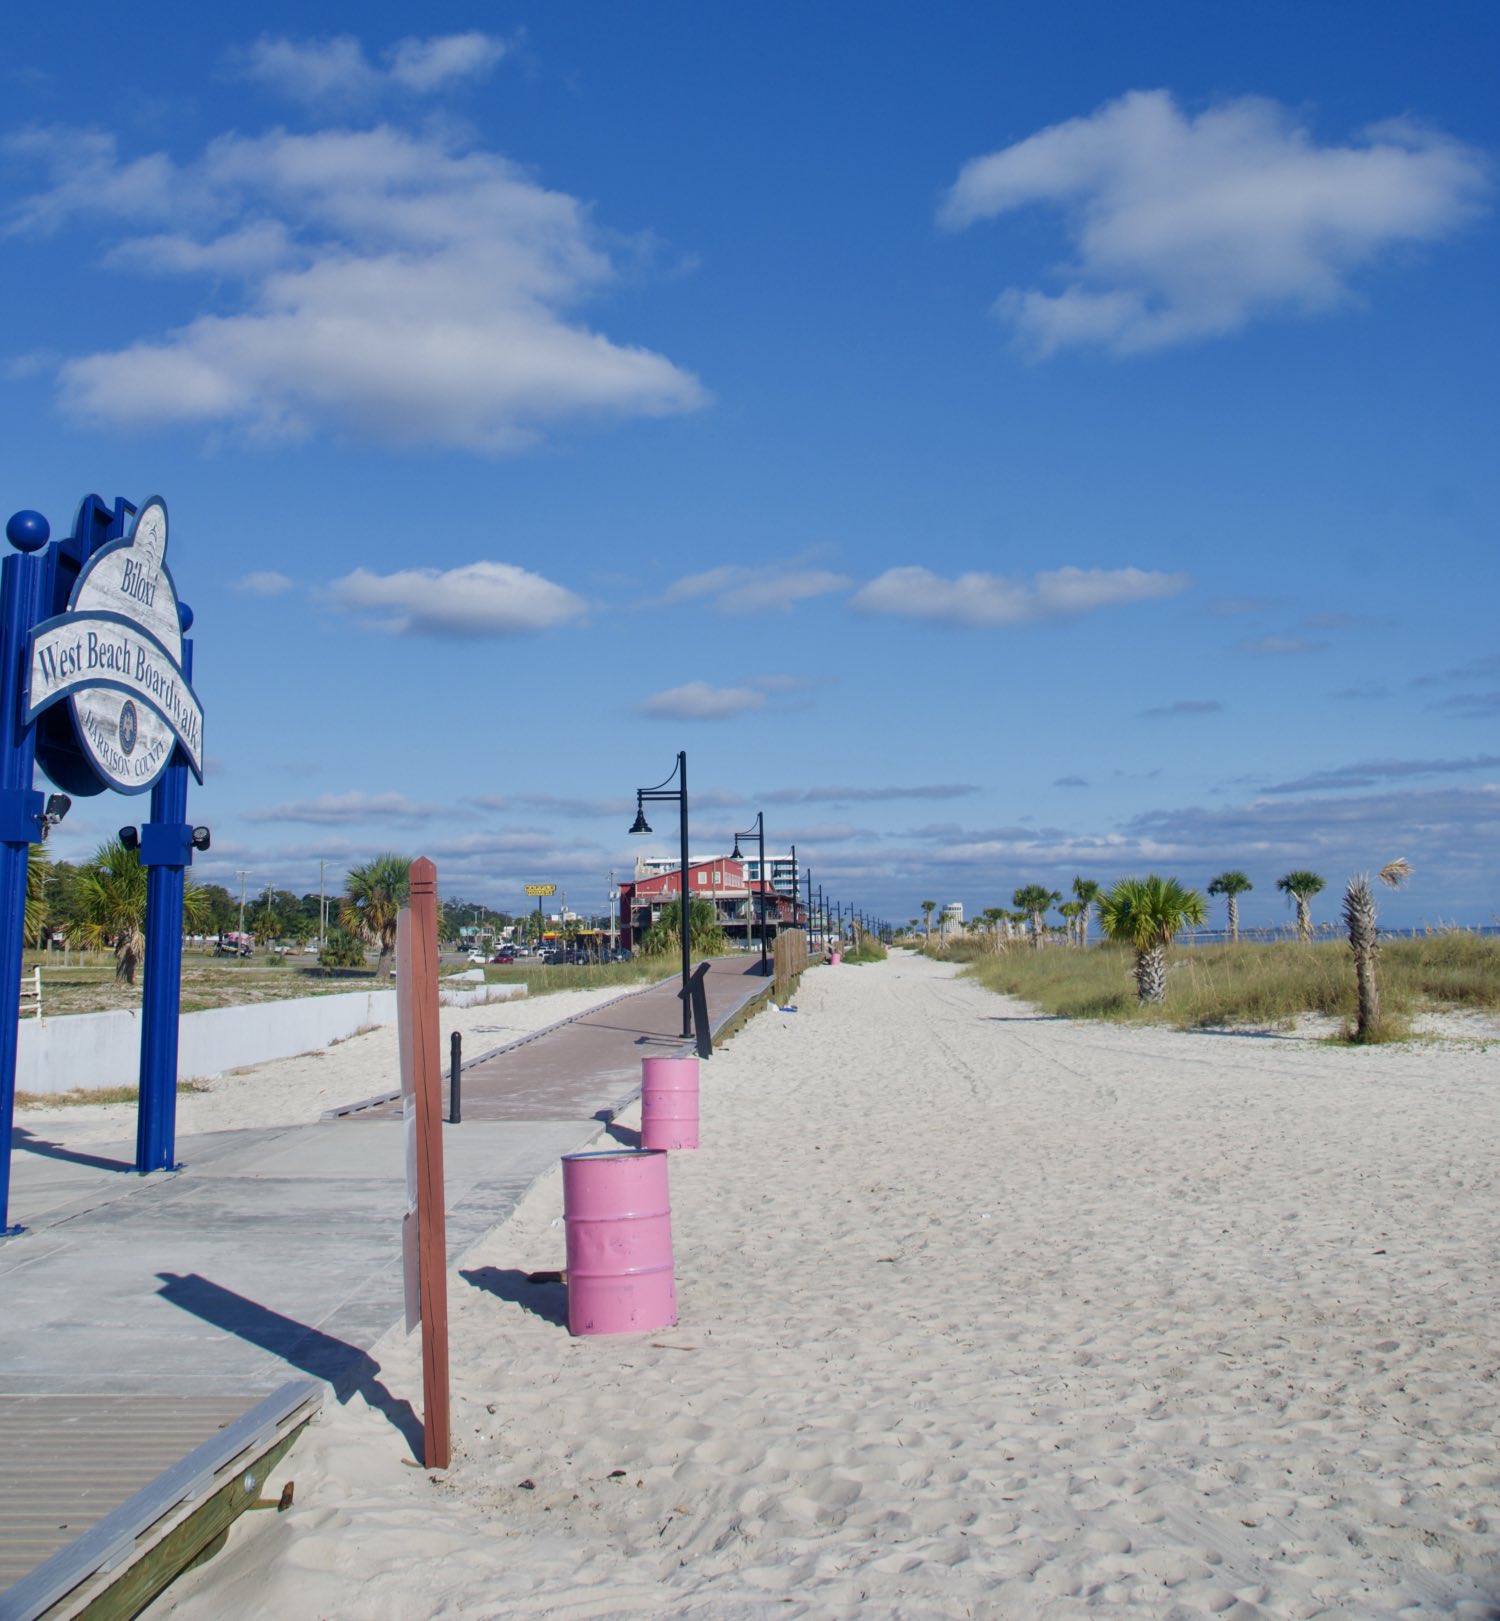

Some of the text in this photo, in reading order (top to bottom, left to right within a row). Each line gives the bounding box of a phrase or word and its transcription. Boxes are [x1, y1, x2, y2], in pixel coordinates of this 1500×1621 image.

[120, 558, 158, 607] Biloxi
[38, 636, 82, 686] West
[87, 631, 131, 674] Beach
[134, 645, 200, 751] Boardwalk
[84, 710, 131, 776] HARRISON
[134, 741, 165, 777] COUNTY
